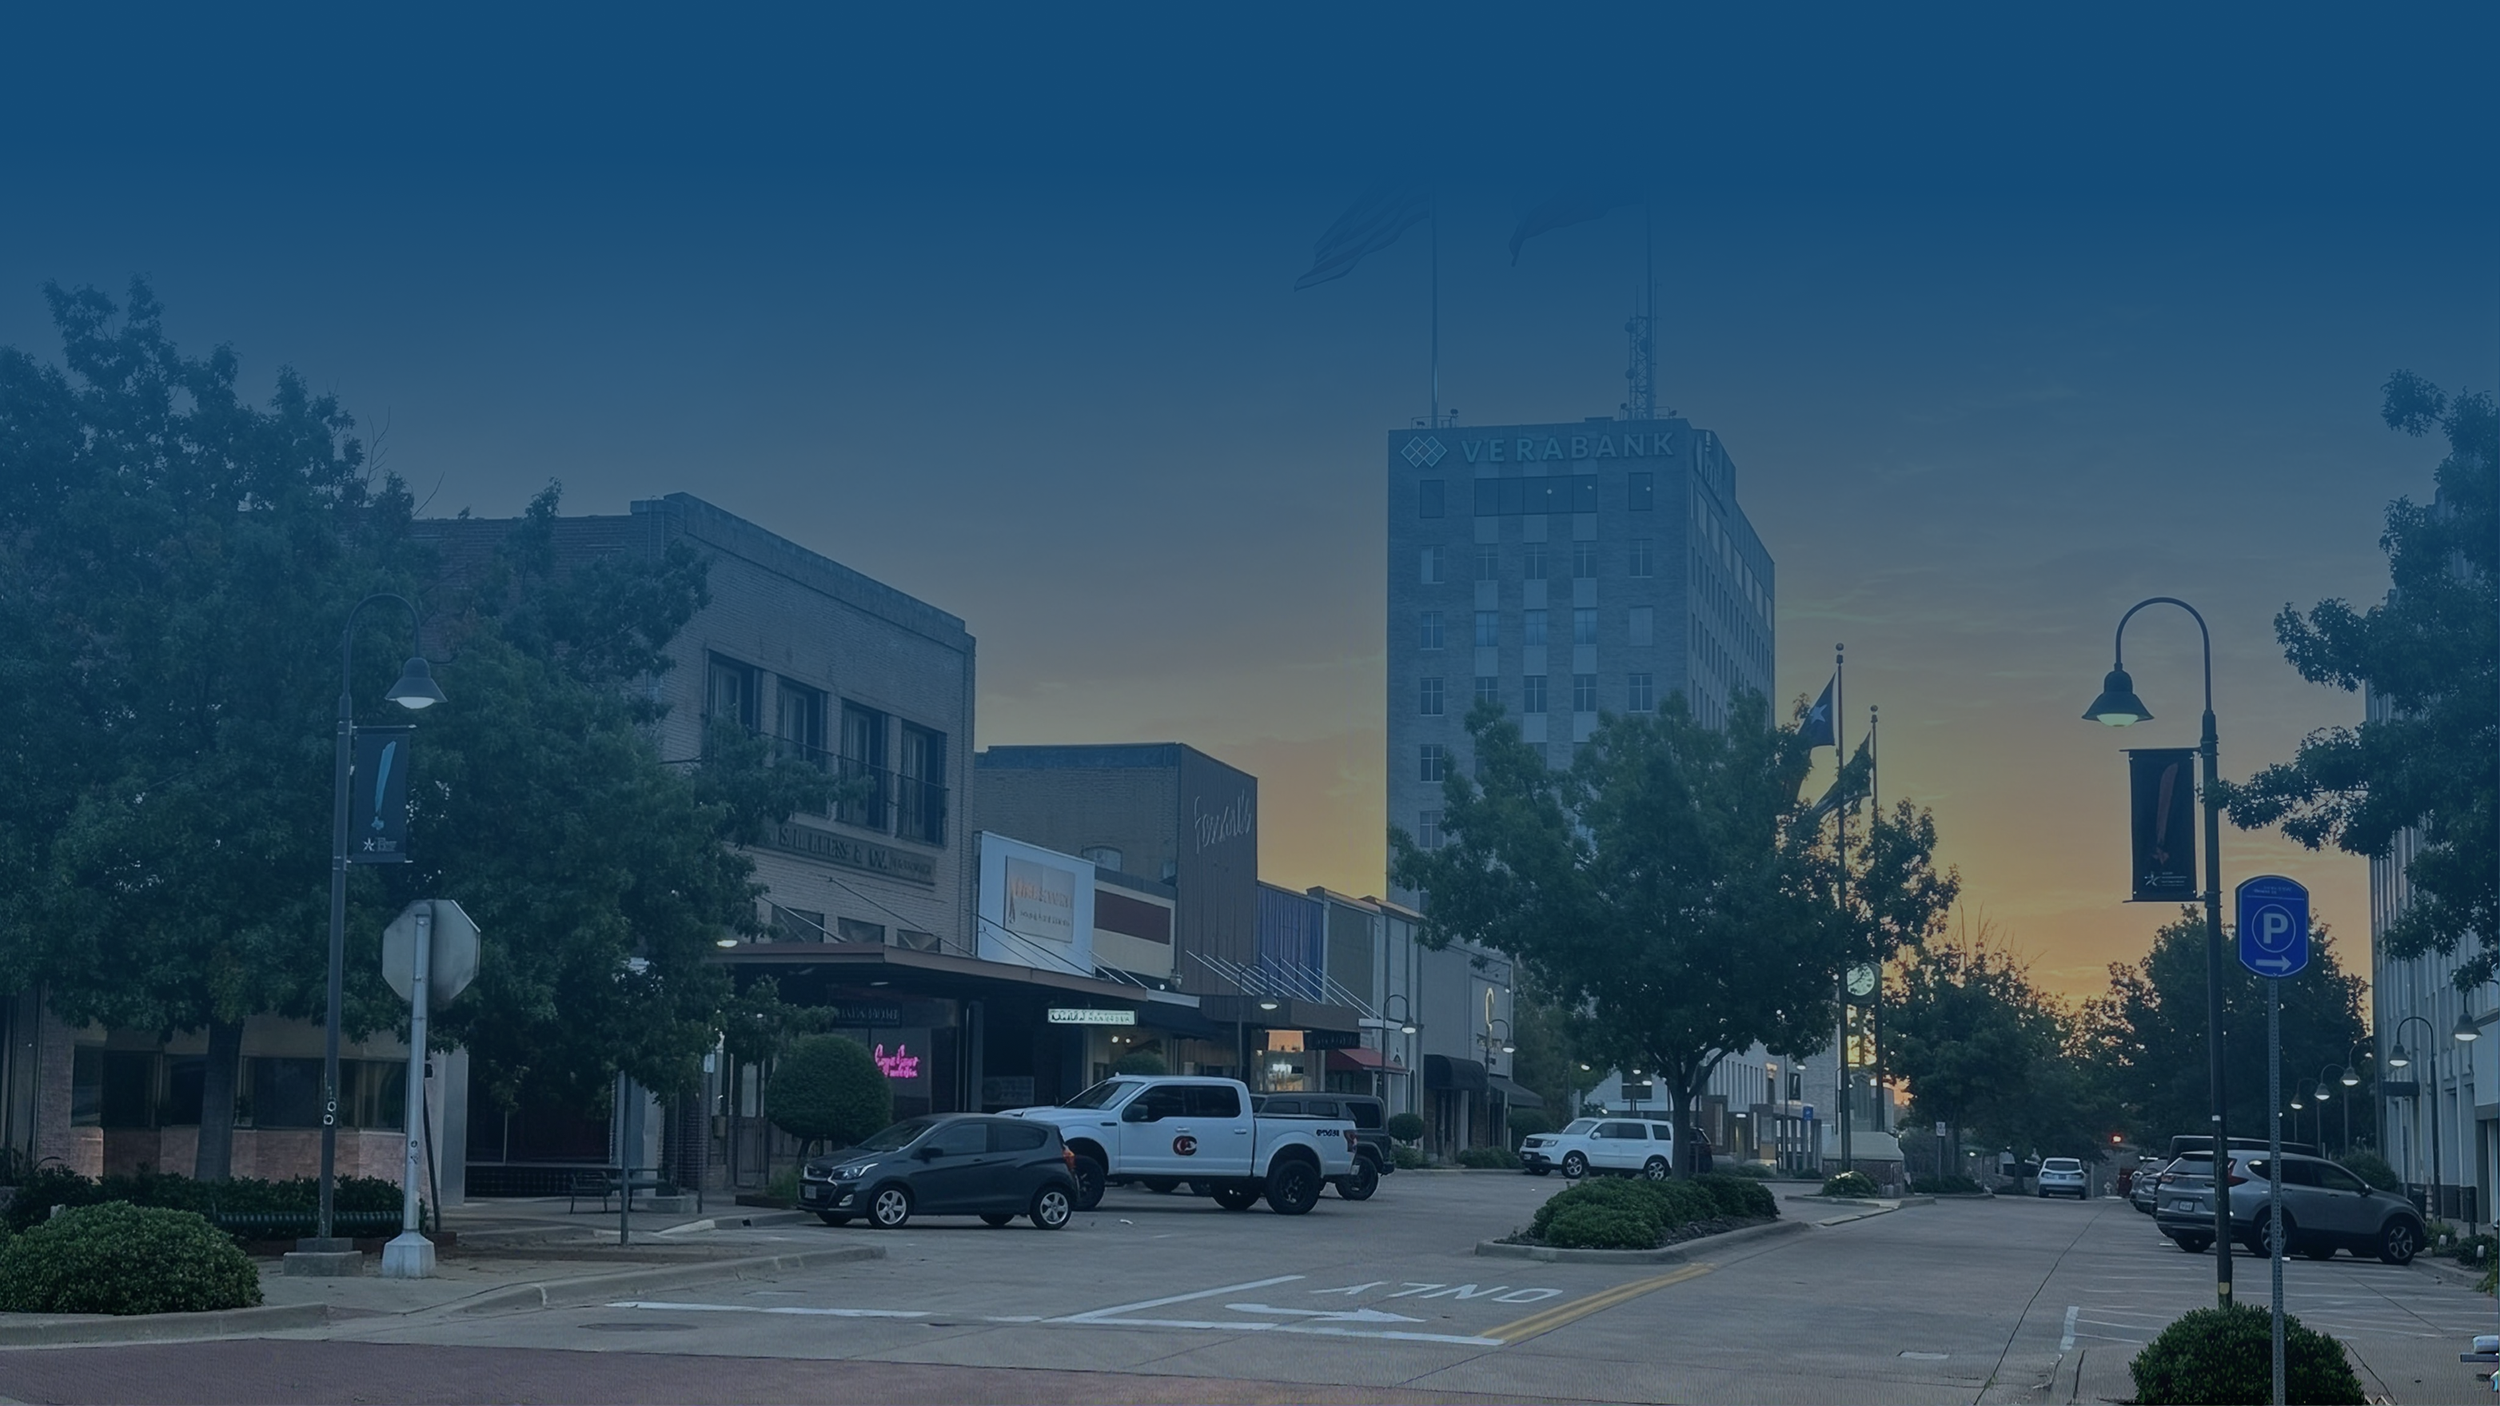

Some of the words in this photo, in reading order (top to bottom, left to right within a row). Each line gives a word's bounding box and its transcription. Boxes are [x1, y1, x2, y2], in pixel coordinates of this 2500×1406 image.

[1461, 431, 1674, 463] VERABANK
[2263, 912, 2289, 944] P
[1308, 1281, 1564, 1304] ONLY
